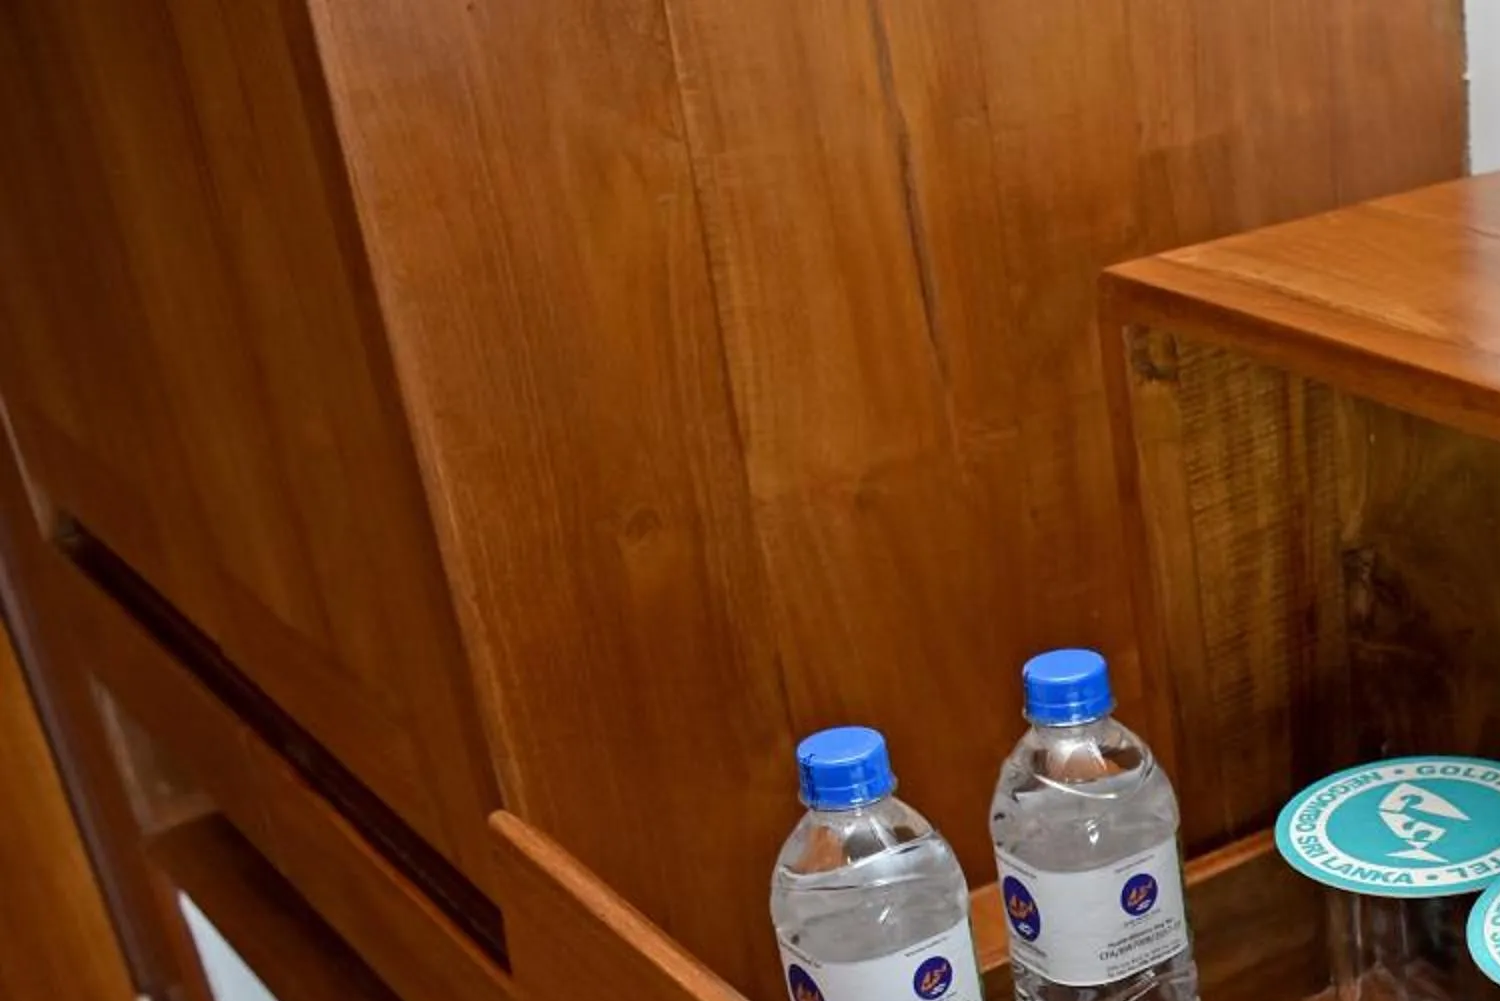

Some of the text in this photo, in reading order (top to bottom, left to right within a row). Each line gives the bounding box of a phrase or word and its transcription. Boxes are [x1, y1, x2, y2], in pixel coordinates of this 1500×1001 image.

[1296, 771, 1414, 885] NEGOMBO SRI LANKA
